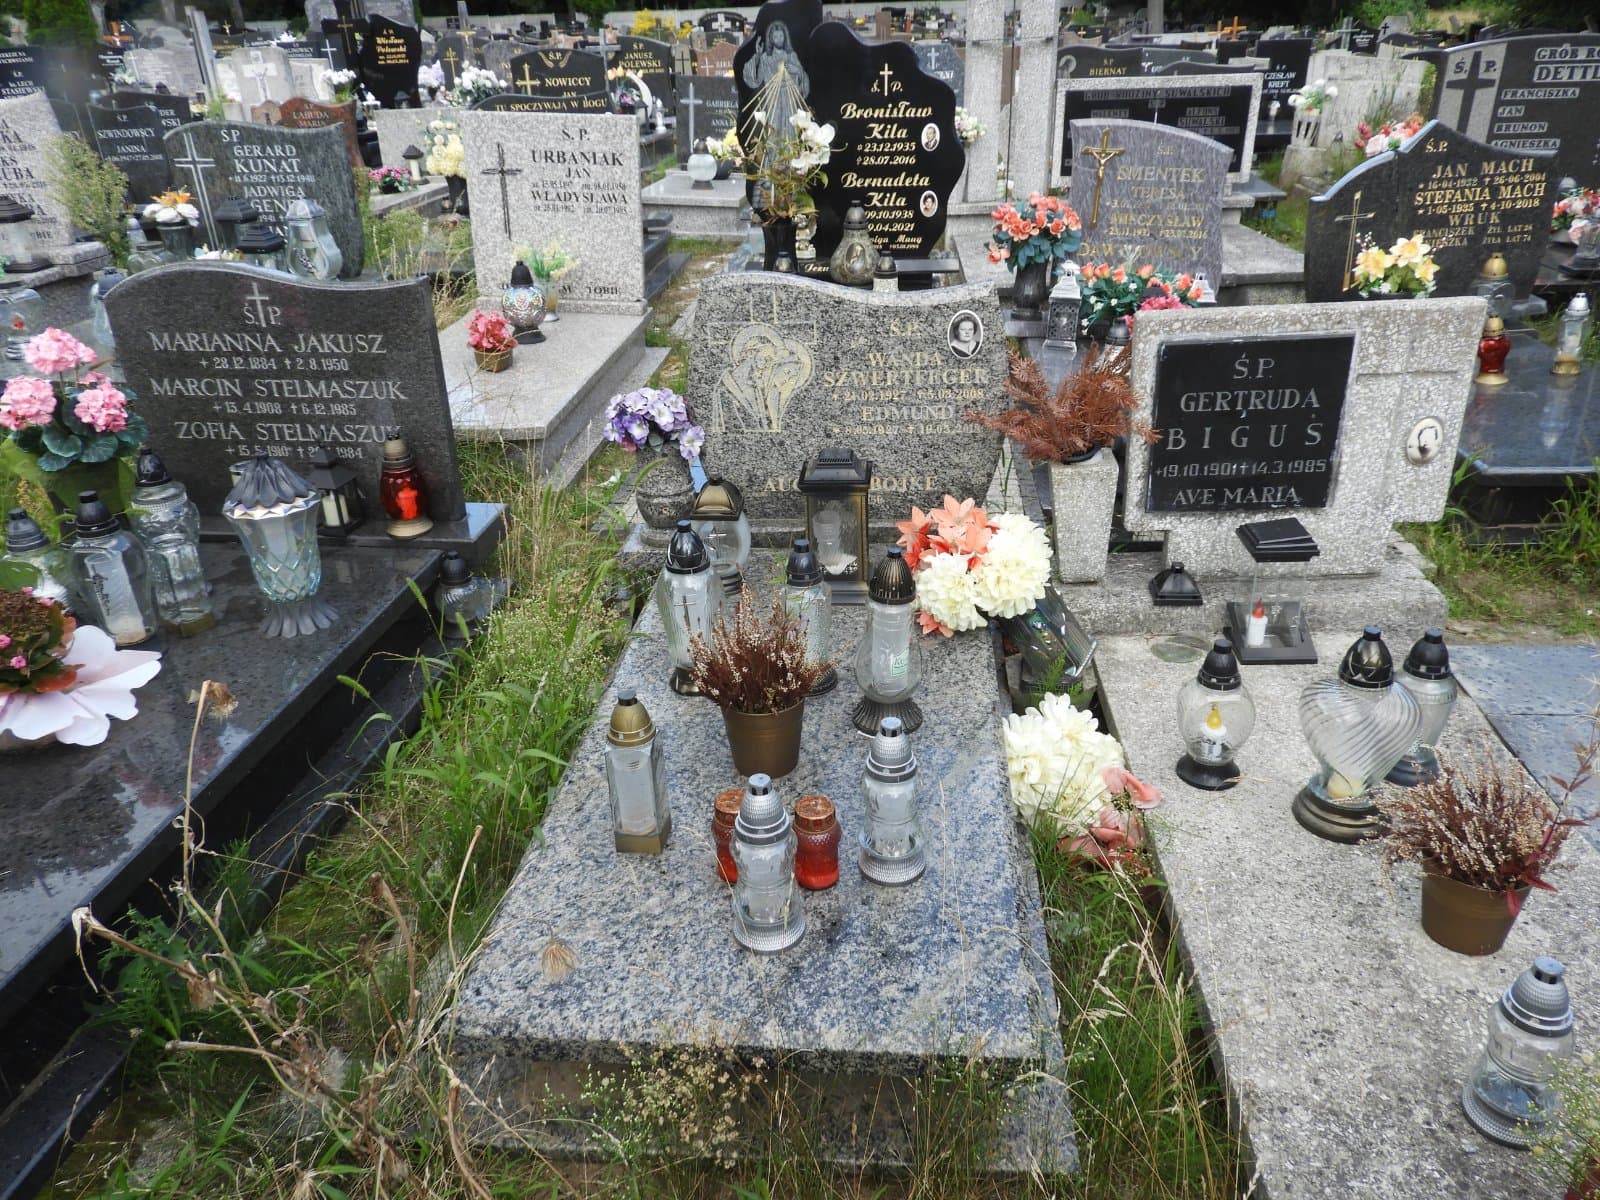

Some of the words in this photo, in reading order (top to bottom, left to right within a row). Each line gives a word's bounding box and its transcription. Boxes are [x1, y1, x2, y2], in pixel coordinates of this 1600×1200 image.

[1537, 44, 1579, 59] GRÓB
[1089, 67, 1127, 76] BIERNAT
[544, 76, 591, 87] NOWICCY
[1503, 88, 1577, 98] FRANCISZKA
[510, 101, 567, 111] SPOCZYWAJĄ
[583, 98, 608, 108] BOGU
[841, 101, 933, 118] Bronisław
[1499, 107, 1524, 115] JAN
[864, 123, 908, 139] Kila
[1495, 122, 1546, 132] BRUNON
[233, 145, 297, 157] GERARD
[531, 150, 623, 166] URBANIAK
[235, 159, 300, 173] KUNAT
[565, 168, 591, 178] JAN
[1432, 163, 1469, 178] JAN
[1481, 159, 1535, 175] MACH
[841, 172, 931, 188] Bernadeta
[1118, 166, 1206, 183] SMENTEK
[243, 186, 306, 198] JADWIGA
[531, 190, 628, 204] WŁADYSŁAWA
[864, 191, 908, 207] Kila
[1131, 186, 1185, 199] TERESA
[1414, 187, 1491, 206] STEFANIA
[1498, 182, 1547, 199] MACH
[1448, 212, 1500, 226] WRUK
[147, 331, 283, 353] MARIANNA
[293, 333, 387, 355] JAKUSZ
[150, 378, 244, 398] MARCIN
[255, 379, 409, 400] STELMASZUK
[1180, 387, 1321, 413] GERTRUDA
[862, 405, 955, 421] EDMUND
[174, 422, 246, 441] ZOFIA
[1172, 488, 1217, 505] AVE
[1223, 486, 1303, 505] MARIA
